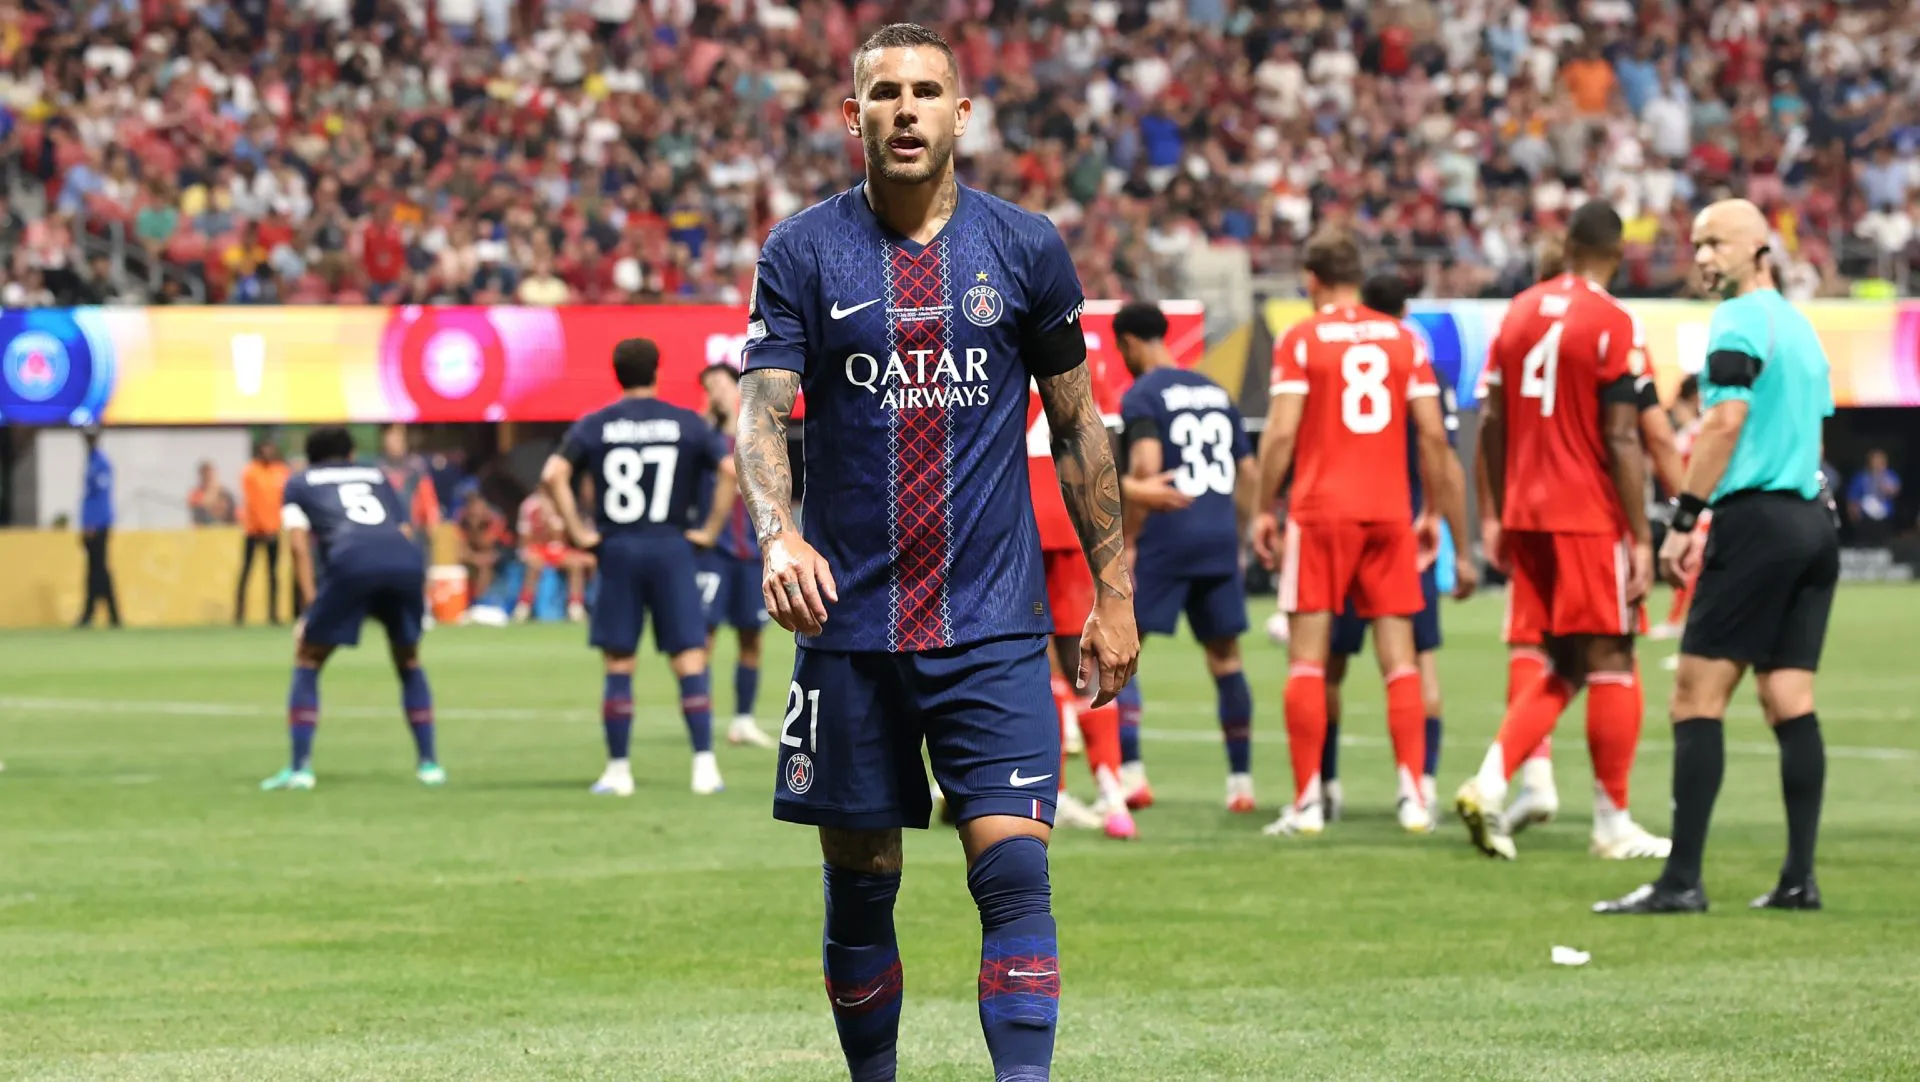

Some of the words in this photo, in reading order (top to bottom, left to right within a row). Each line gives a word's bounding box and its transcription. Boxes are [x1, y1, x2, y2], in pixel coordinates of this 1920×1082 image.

[968, 287, 996, 298] PARIS
[845, 347, 989, 394] QATAR
[879, 384, 990, 409] AIRWAYS
[1341, 344, 1393, 434] 8
[1521, 320, 1563, 416] 4
[603, 445, 679, 523] 87
[1169, 411, 1236, 497] 33
[337, 482, 387, 525] 5
[780, 680, 821, 753] 21
[792, 755, 811, 769] PARIS
